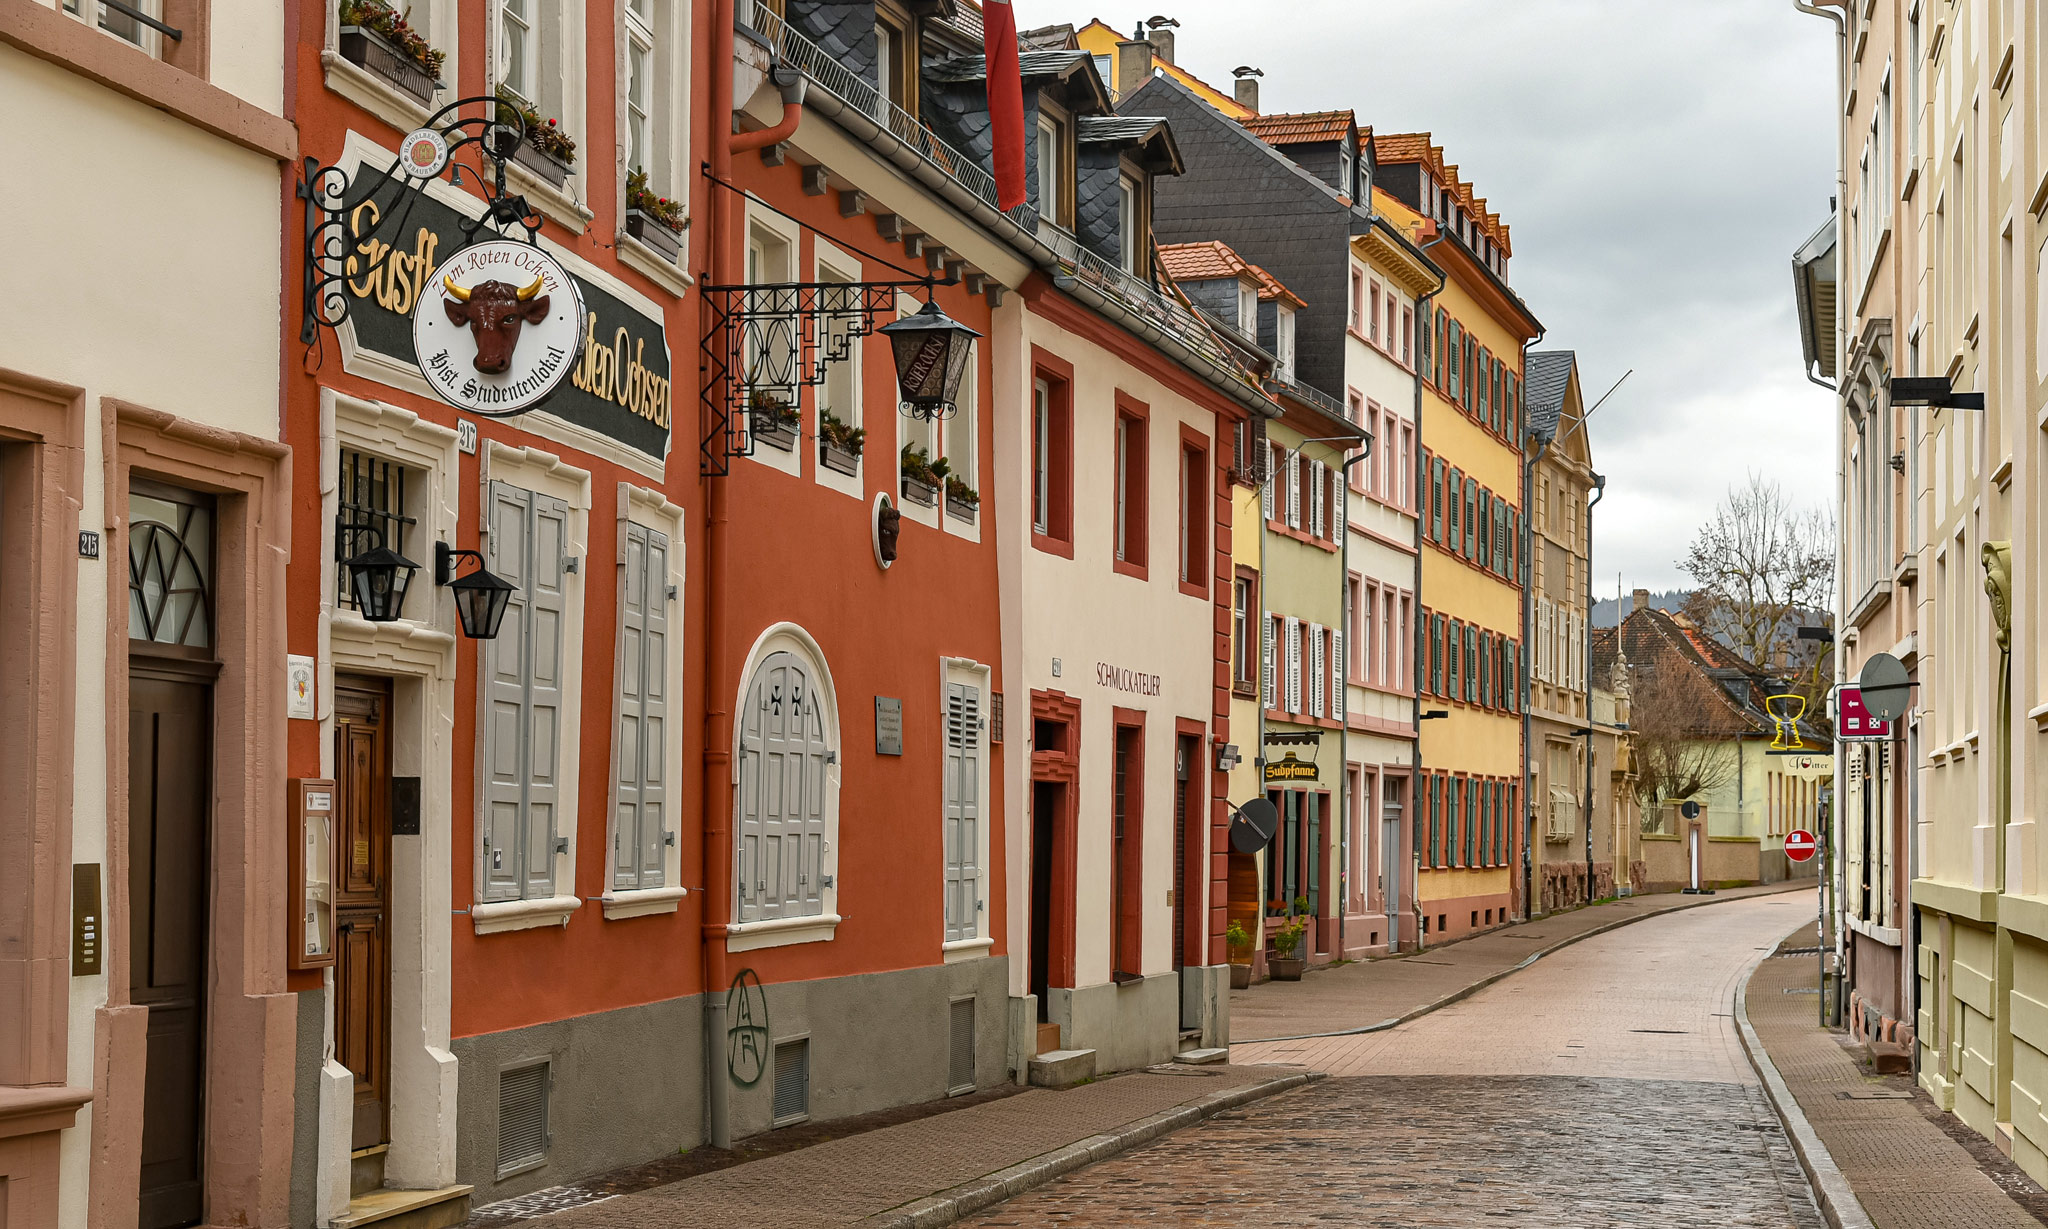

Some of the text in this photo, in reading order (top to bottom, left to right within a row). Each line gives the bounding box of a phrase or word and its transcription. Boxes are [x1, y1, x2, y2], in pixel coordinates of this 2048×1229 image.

[467, 250, 510, 270] Roten
[514, 251, 559, 293] Ochsen
[425, 344, 566, 404] Hist. Studentenlokal
[614, 326, 669, 430] Ochsen
[459, 422, 476, 450] 217
[81, 533, 97, 556] 215
[1096, 661, 1160, 697] SCHMUCKATELIER
[1265, 763, 1316, 779] Sudpfanne
